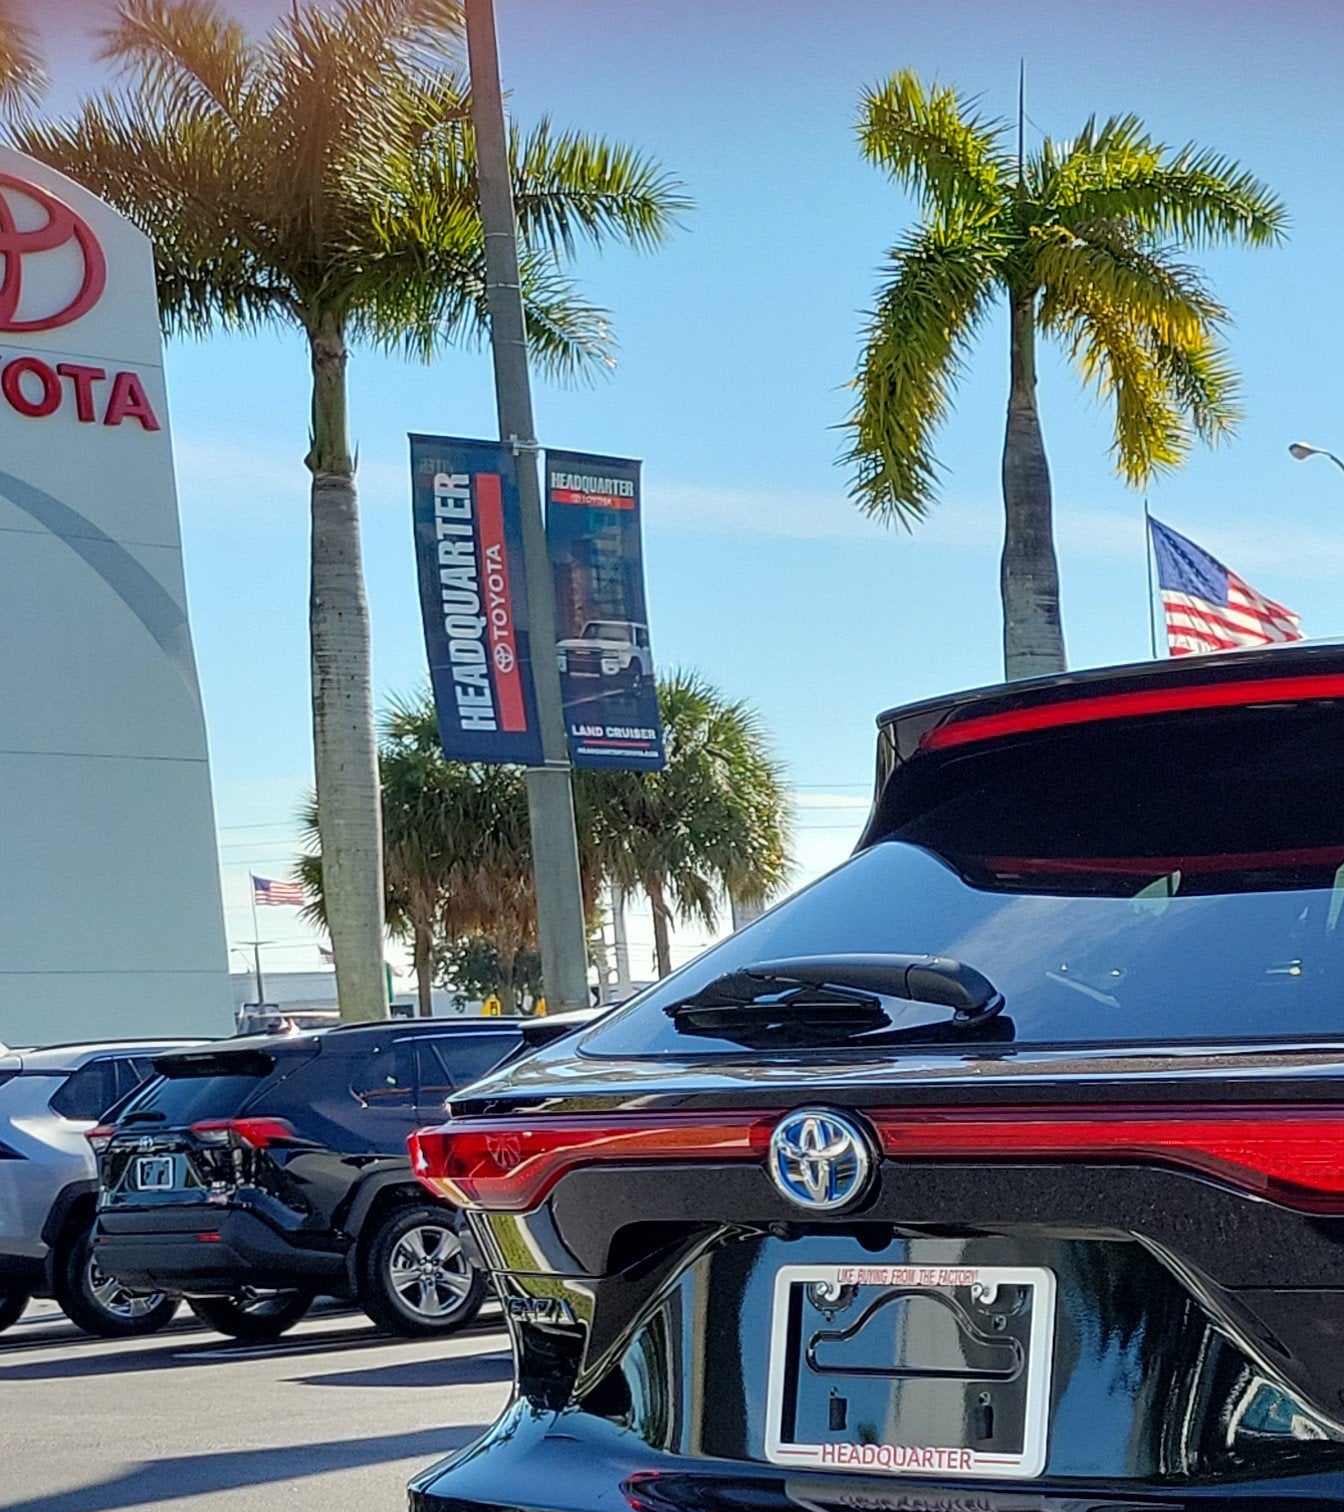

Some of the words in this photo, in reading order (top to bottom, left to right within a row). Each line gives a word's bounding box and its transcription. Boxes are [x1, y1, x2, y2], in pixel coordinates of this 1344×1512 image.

[0, 356, 161, 431] OTA
[551, 472, 634, 497] HEADQUARTER
[434, 472, 497, 731] HEADQUARTER
[486, 544, 511, 640] TOYOTA
[572, 725, 604, 737] LAND
[605, 726, 656, 740] CRUISER
[837, 1268, 853, 1283] LIKE
[891, 1269, 915, 1284] FROM
[919, 1270, 935, 1284] THE
[821, 1444, 972, 1470] HEADQUARTER
